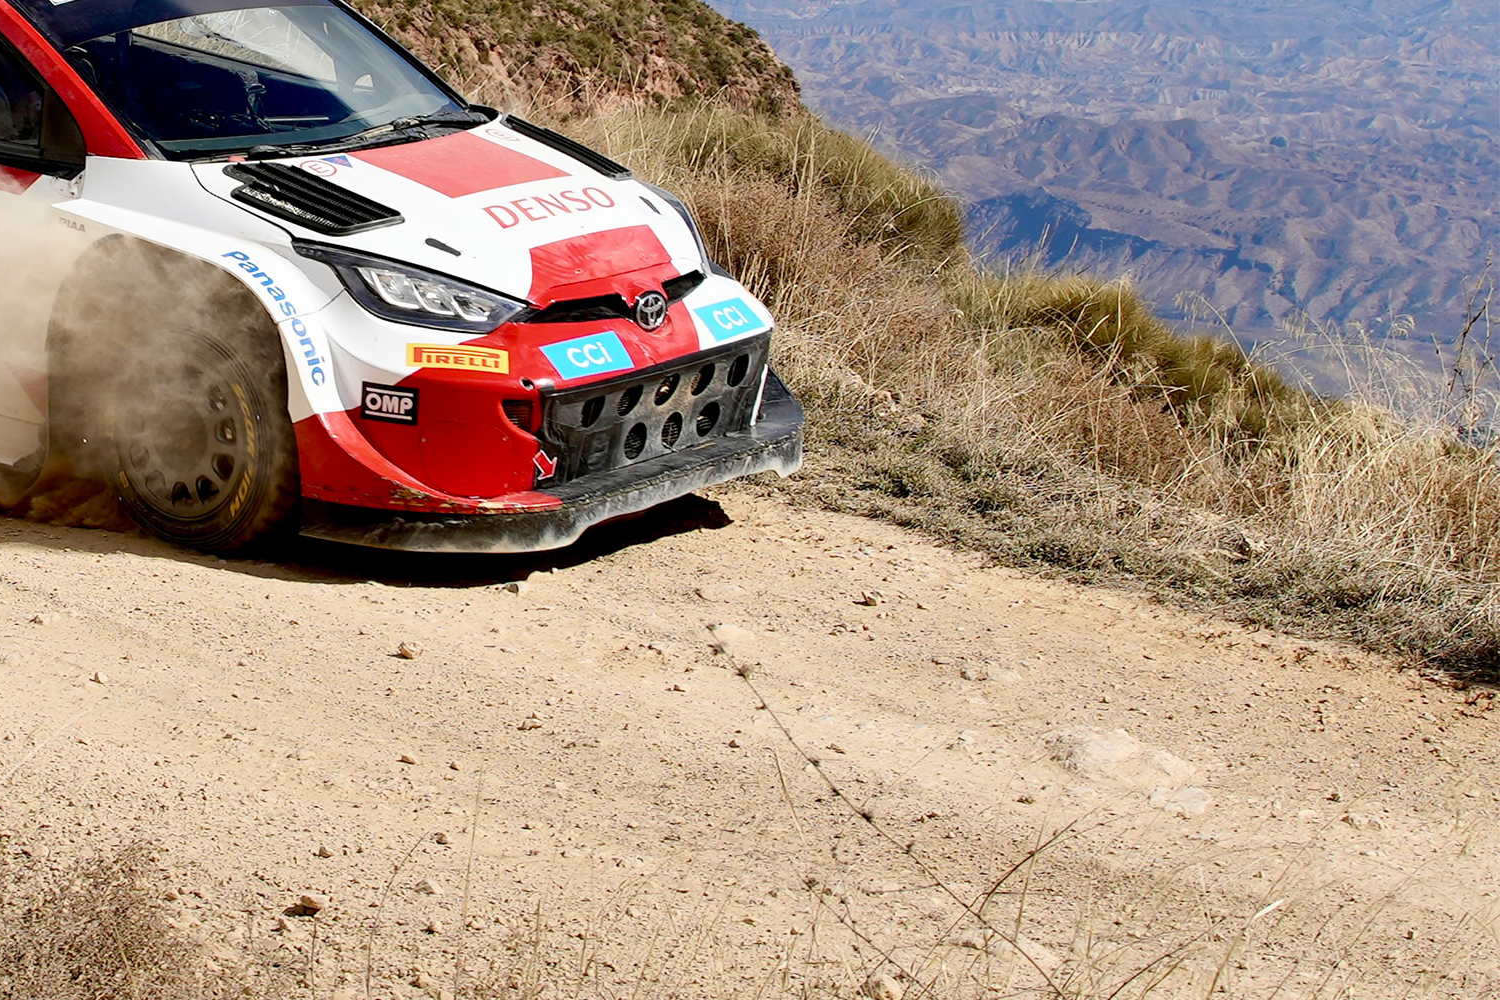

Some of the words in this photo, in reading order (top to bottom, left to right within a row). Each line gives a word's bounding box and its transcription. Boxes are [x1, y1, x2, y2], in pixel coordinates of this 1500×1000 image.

[482, 186, 615, 229] DENSO
[59, 216, 86, 233] PIAA
[221, 250, 326, 387] Panasonic
[413, 346, 501, 370] PIRELLI
[365, 393, 414, 415] OMP
